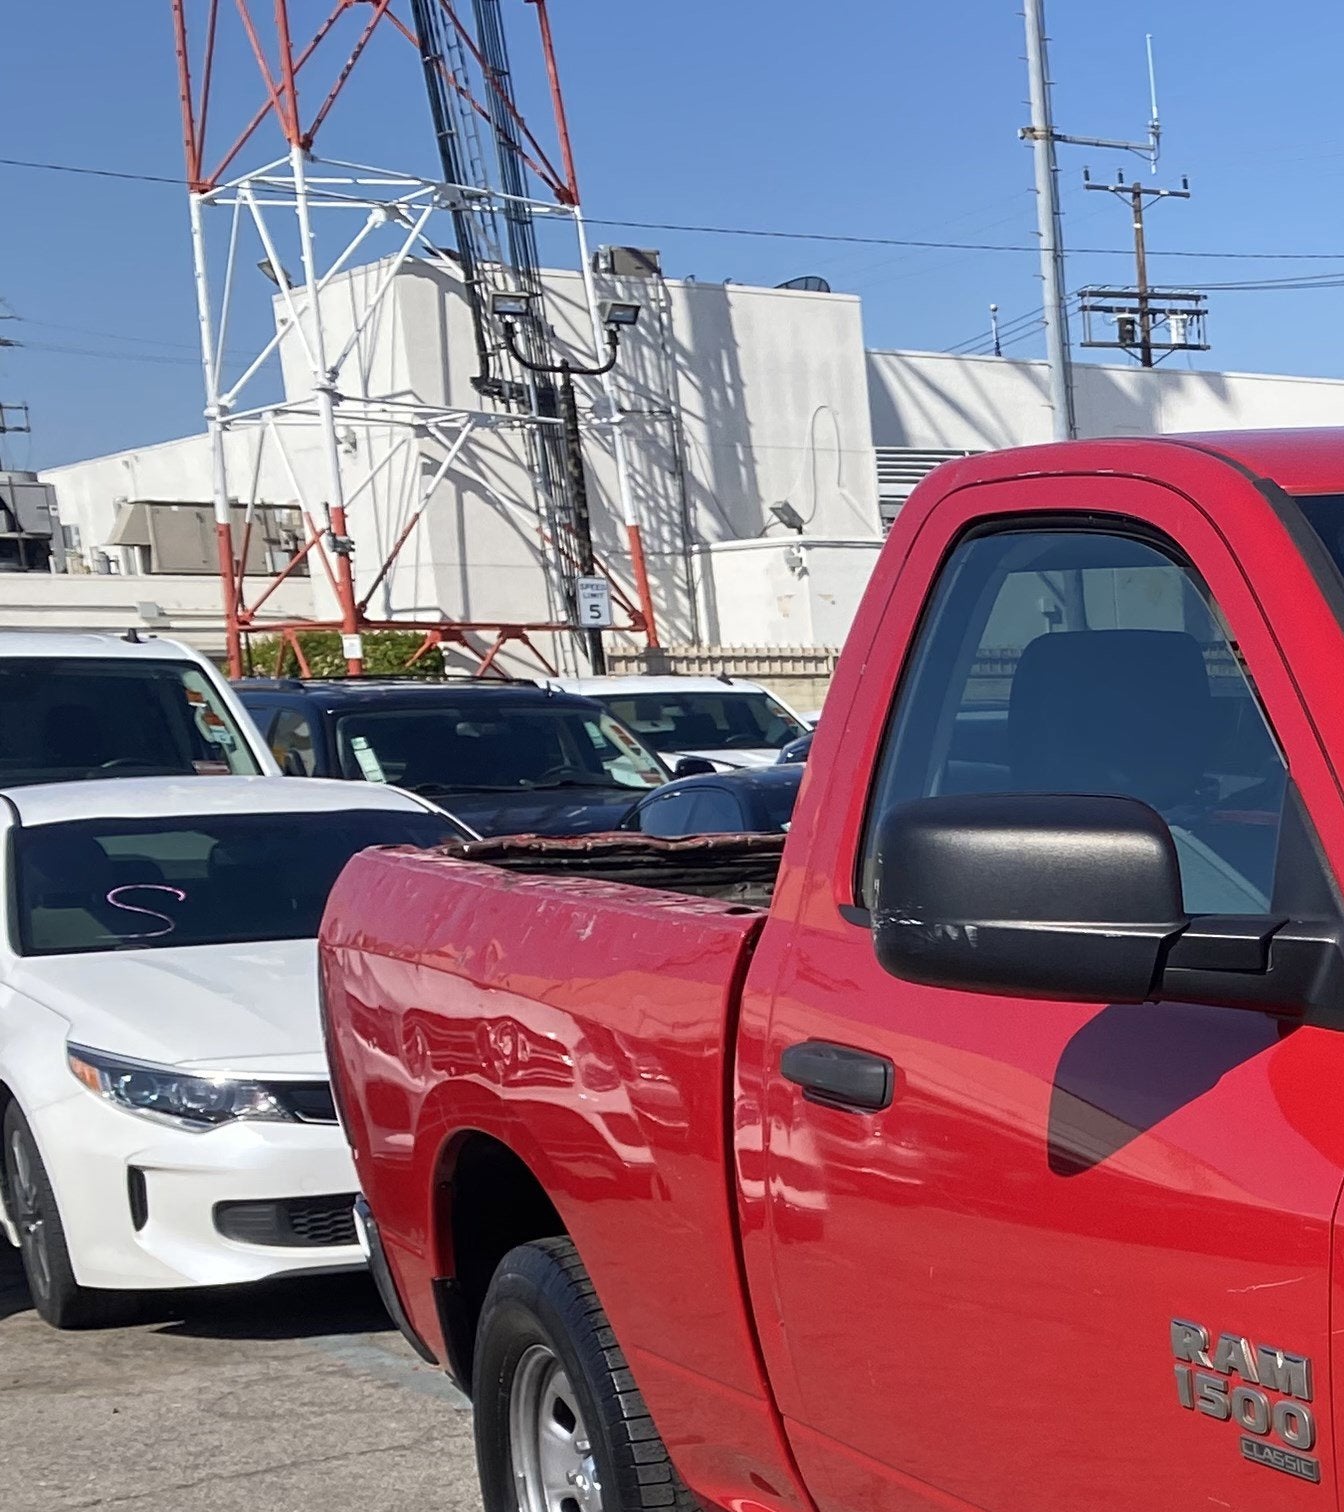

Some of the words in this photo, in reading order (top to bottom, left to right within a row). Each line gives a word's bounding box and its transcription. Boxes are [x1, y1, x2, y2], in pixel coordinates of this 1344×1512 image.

[589, 604, 602, 619] 5
[1171, 1317, 1313, 1403] RAM
[1174, 1364, 1317, 1452] 1500
[1242, 1440, 1316, 1478] CLASSIC
